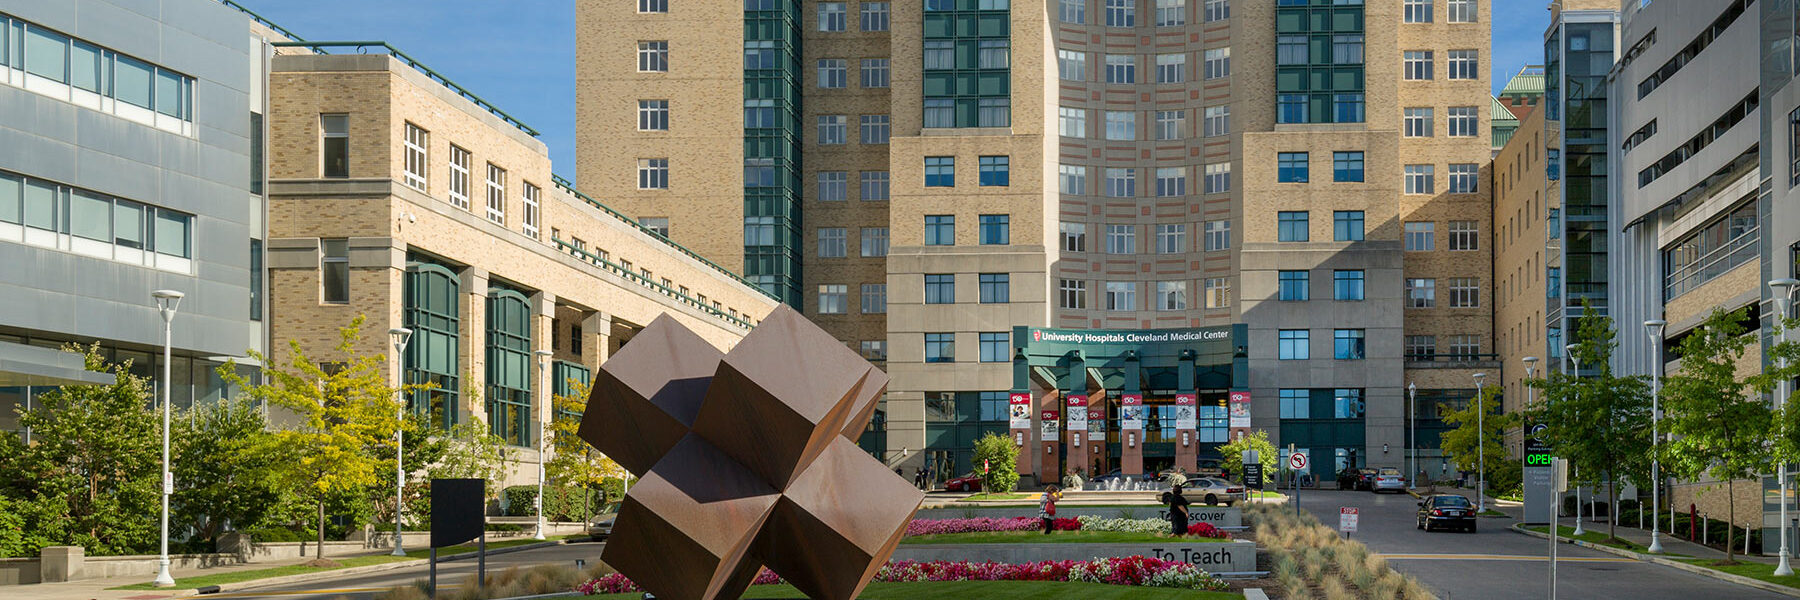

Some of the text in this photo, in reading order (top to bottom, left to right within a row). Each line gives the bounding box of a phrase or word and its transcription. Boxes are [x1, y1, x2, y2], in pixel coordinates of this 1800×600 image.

[1042, 331, 1229, 343] University Hospitals Cleveland Medical Center
[1186, 511, 1225, 521] scover
[1152, 547, 1231, 565] To Teach
